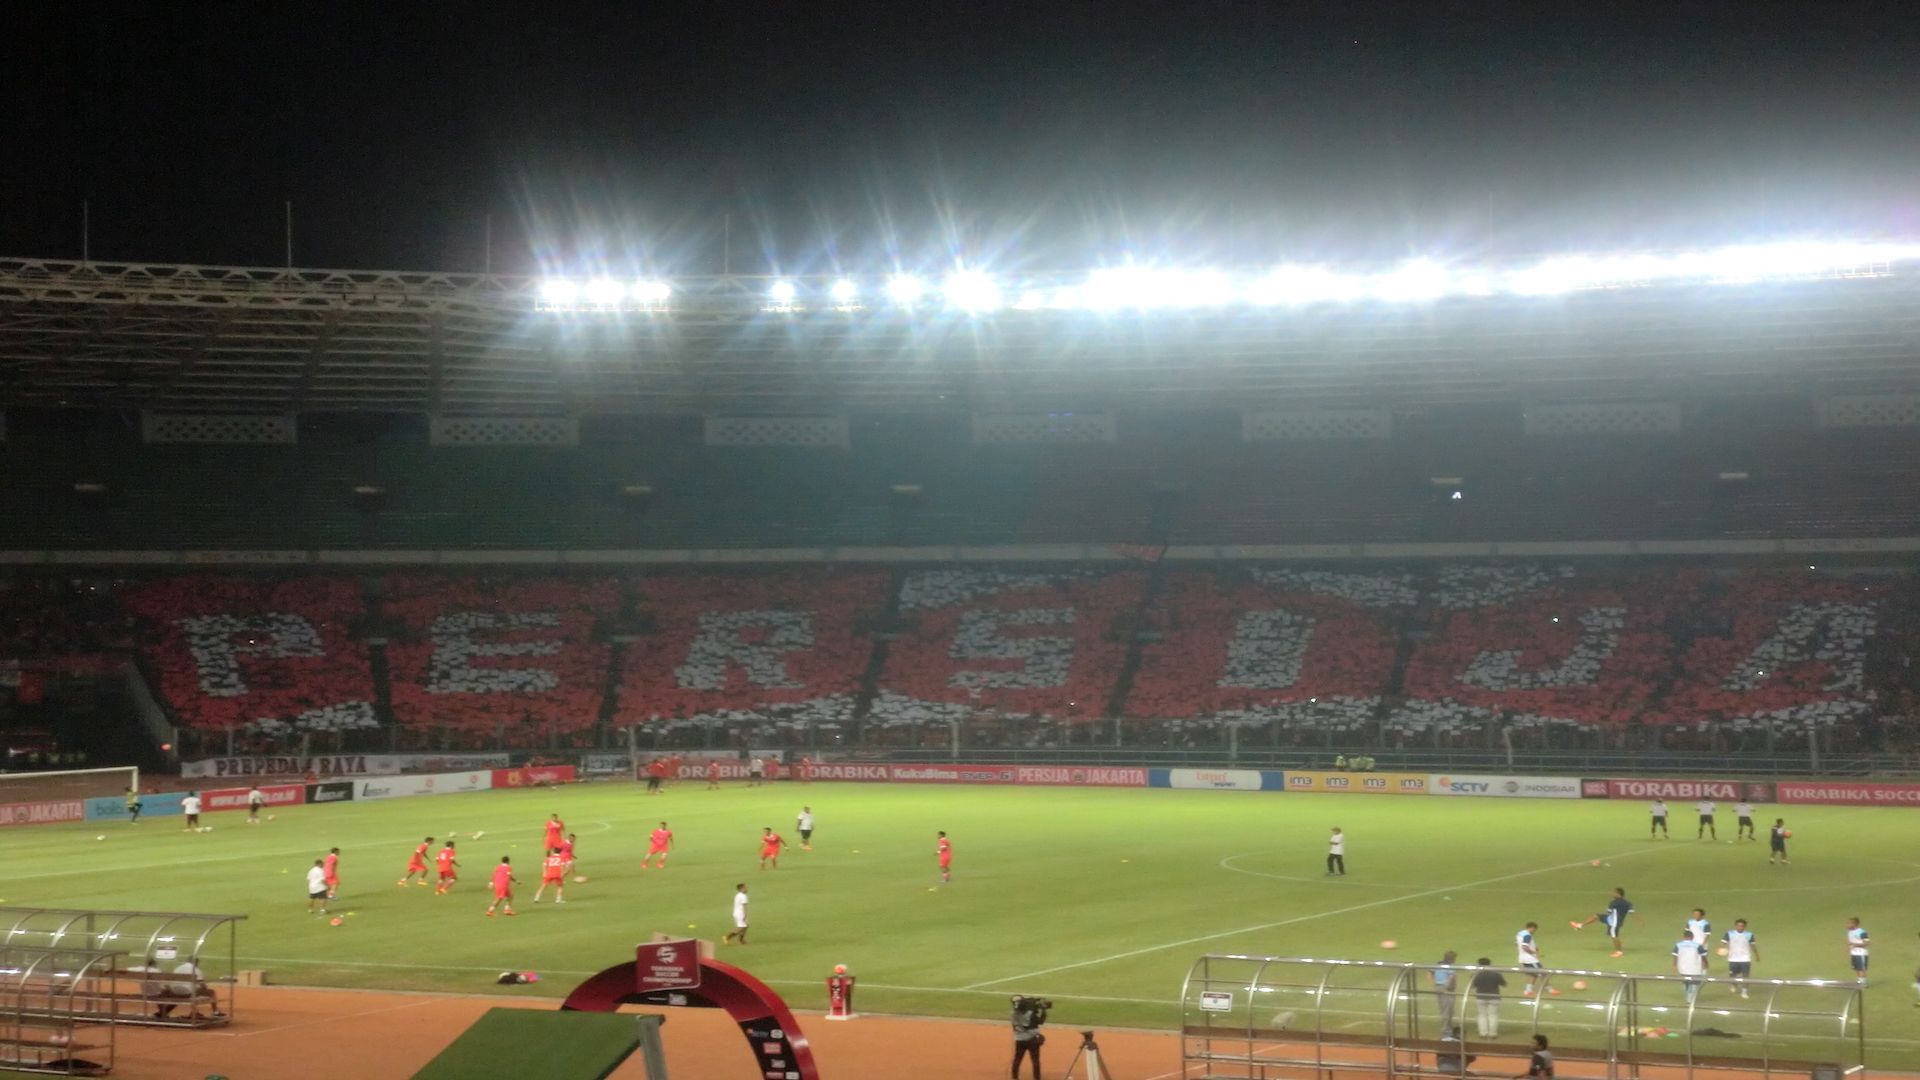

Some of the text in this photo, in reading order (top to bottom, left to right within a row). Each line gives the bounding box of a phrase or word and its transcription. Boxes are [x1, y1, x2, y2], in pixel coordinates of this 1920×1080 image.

[319, 756, 367, 774] RAYA
[1019, 768, 1145, 785] PERSIJA JAKARTA
[1450, 782, 1489, 792] SCTV
[1525, 784, 1576, 793] INDOSIAR
[1615, 782, 1737, 798] TORABIKA
[1783, 788, 1871, 800] TORABIKA
[30, 802, 82, 822] JAKARTA
